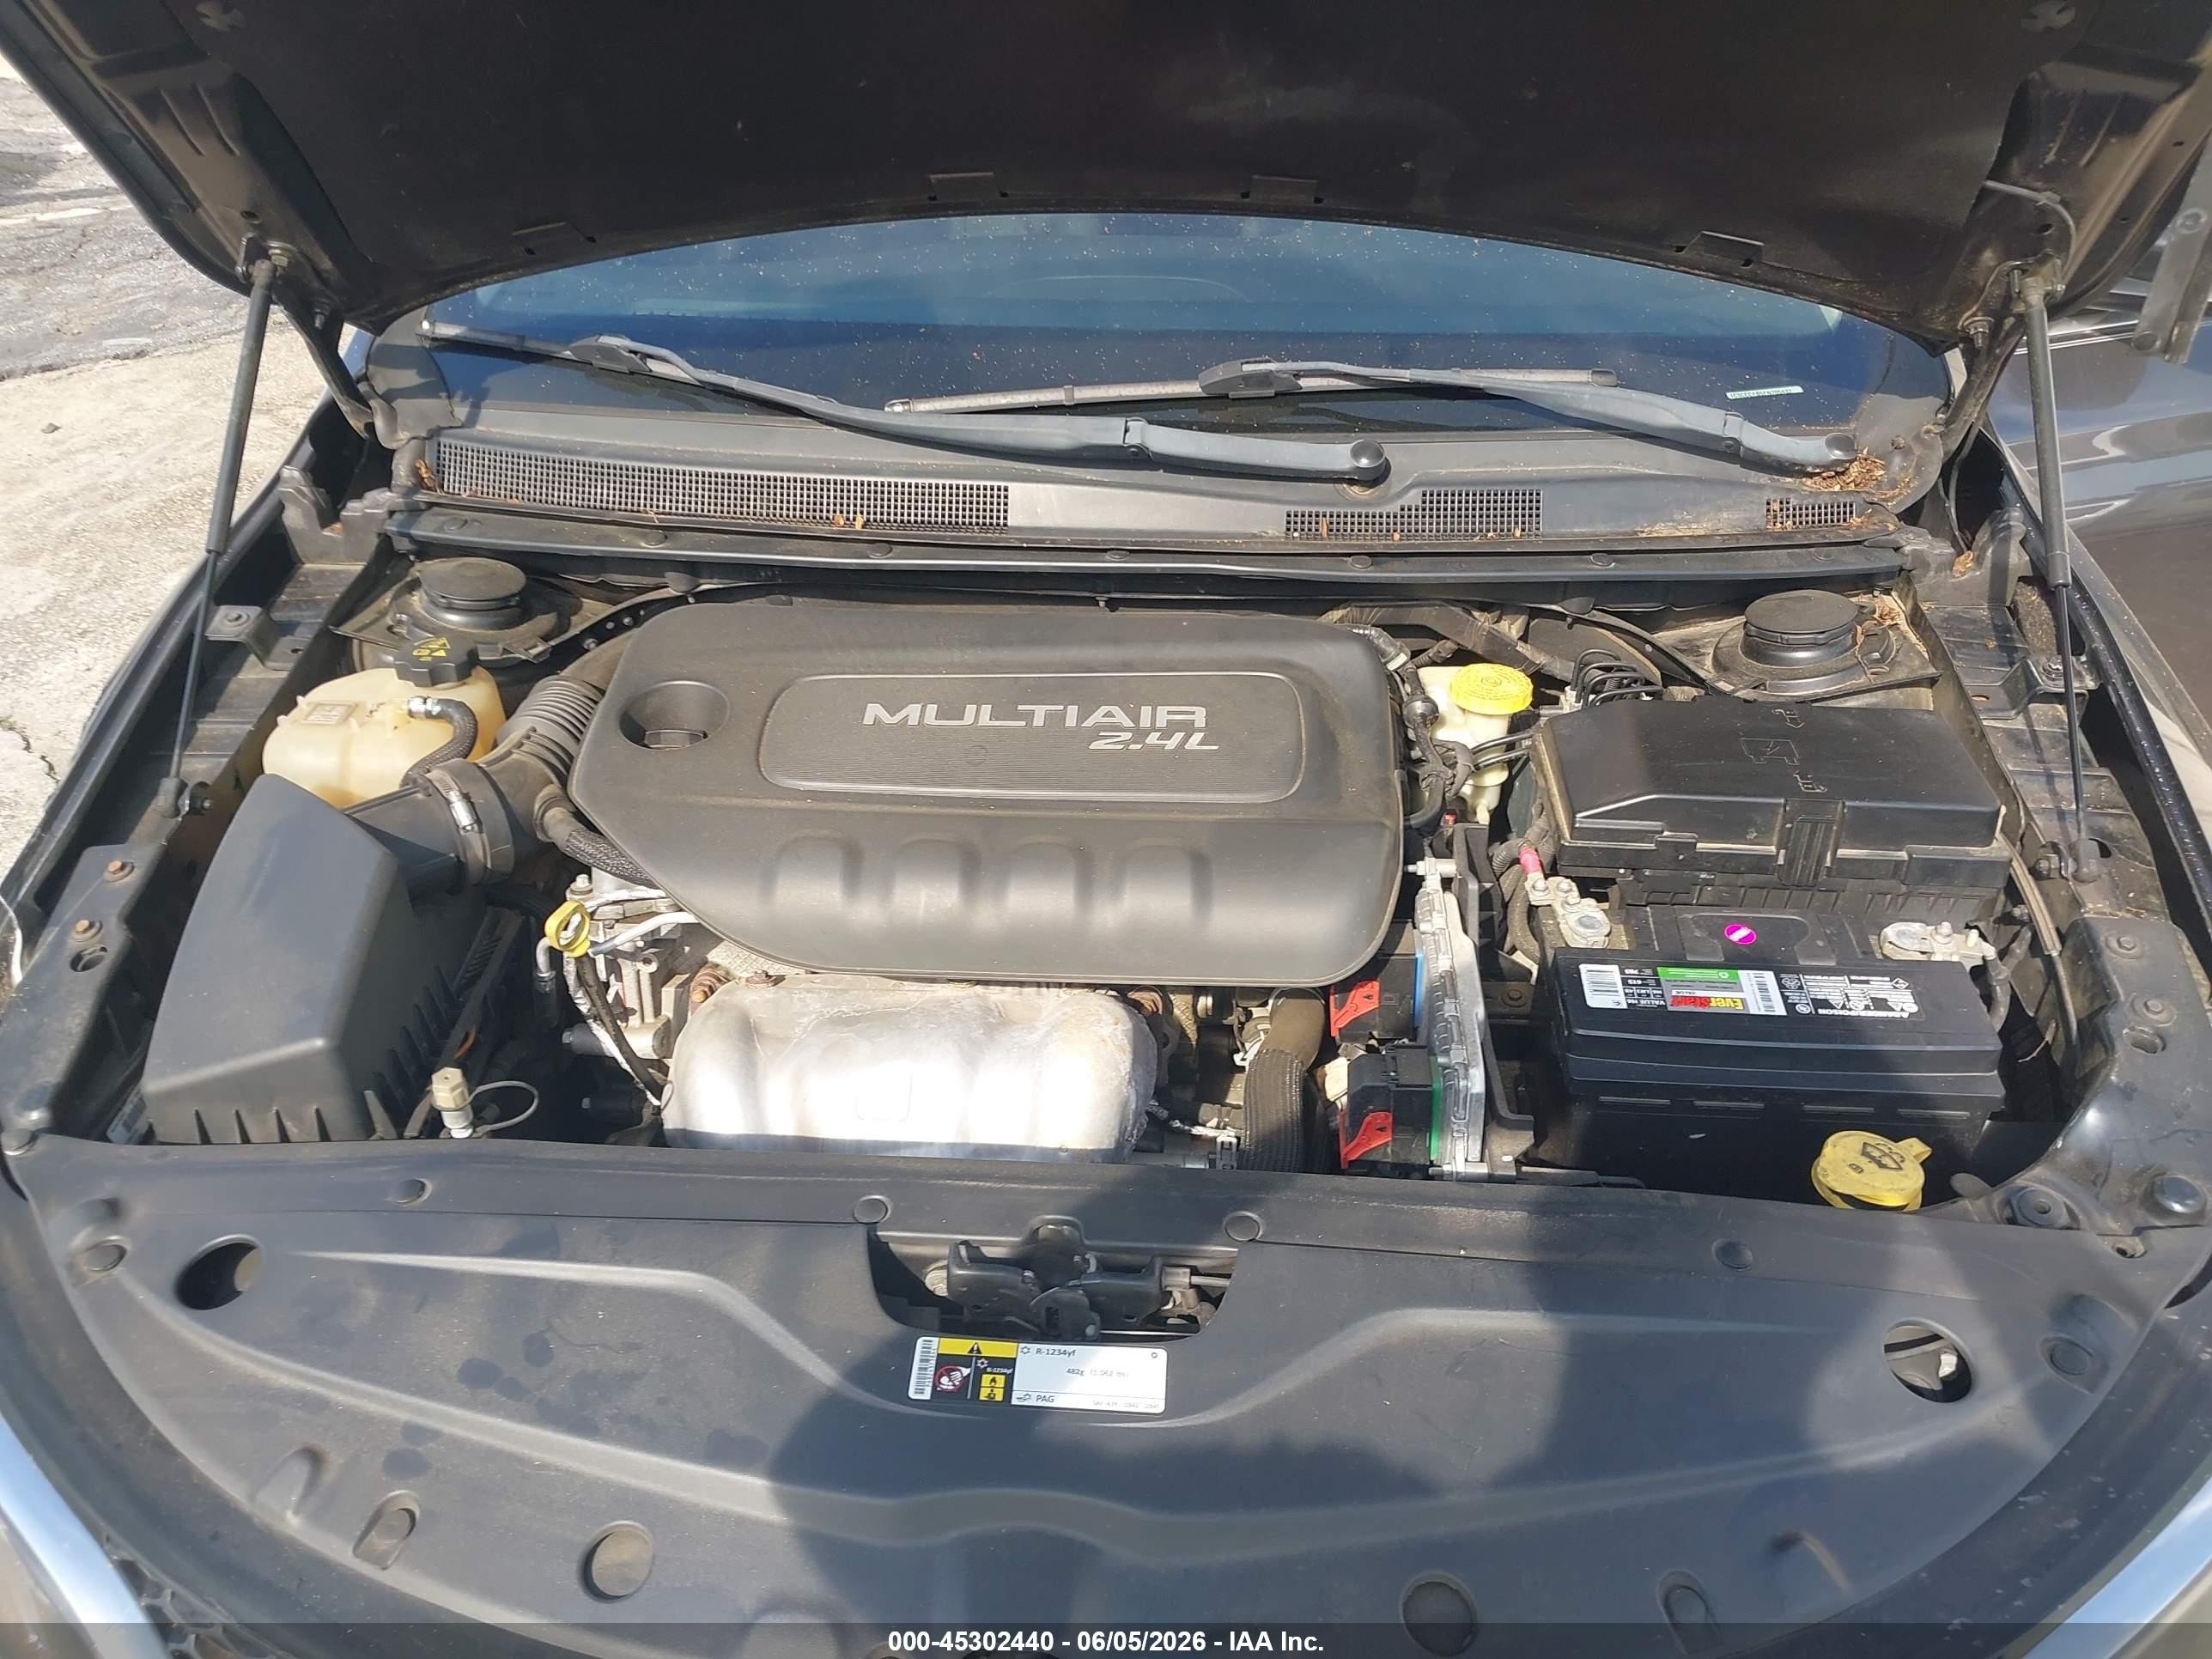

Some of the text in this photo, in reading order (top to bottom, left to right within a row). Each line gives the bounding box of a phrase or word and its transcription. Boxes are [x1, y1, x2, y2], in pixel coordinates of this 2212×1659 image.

[862, 702, 1208, 728] MULTIAIR
[1088, 731, 1220, 750] 2.4L
[1670, 996, 1744, 1010] EverStart
[1036, 1347, 1077, 1358] R-1234yf
[1036, 1394, 1055, 1403] PAG
